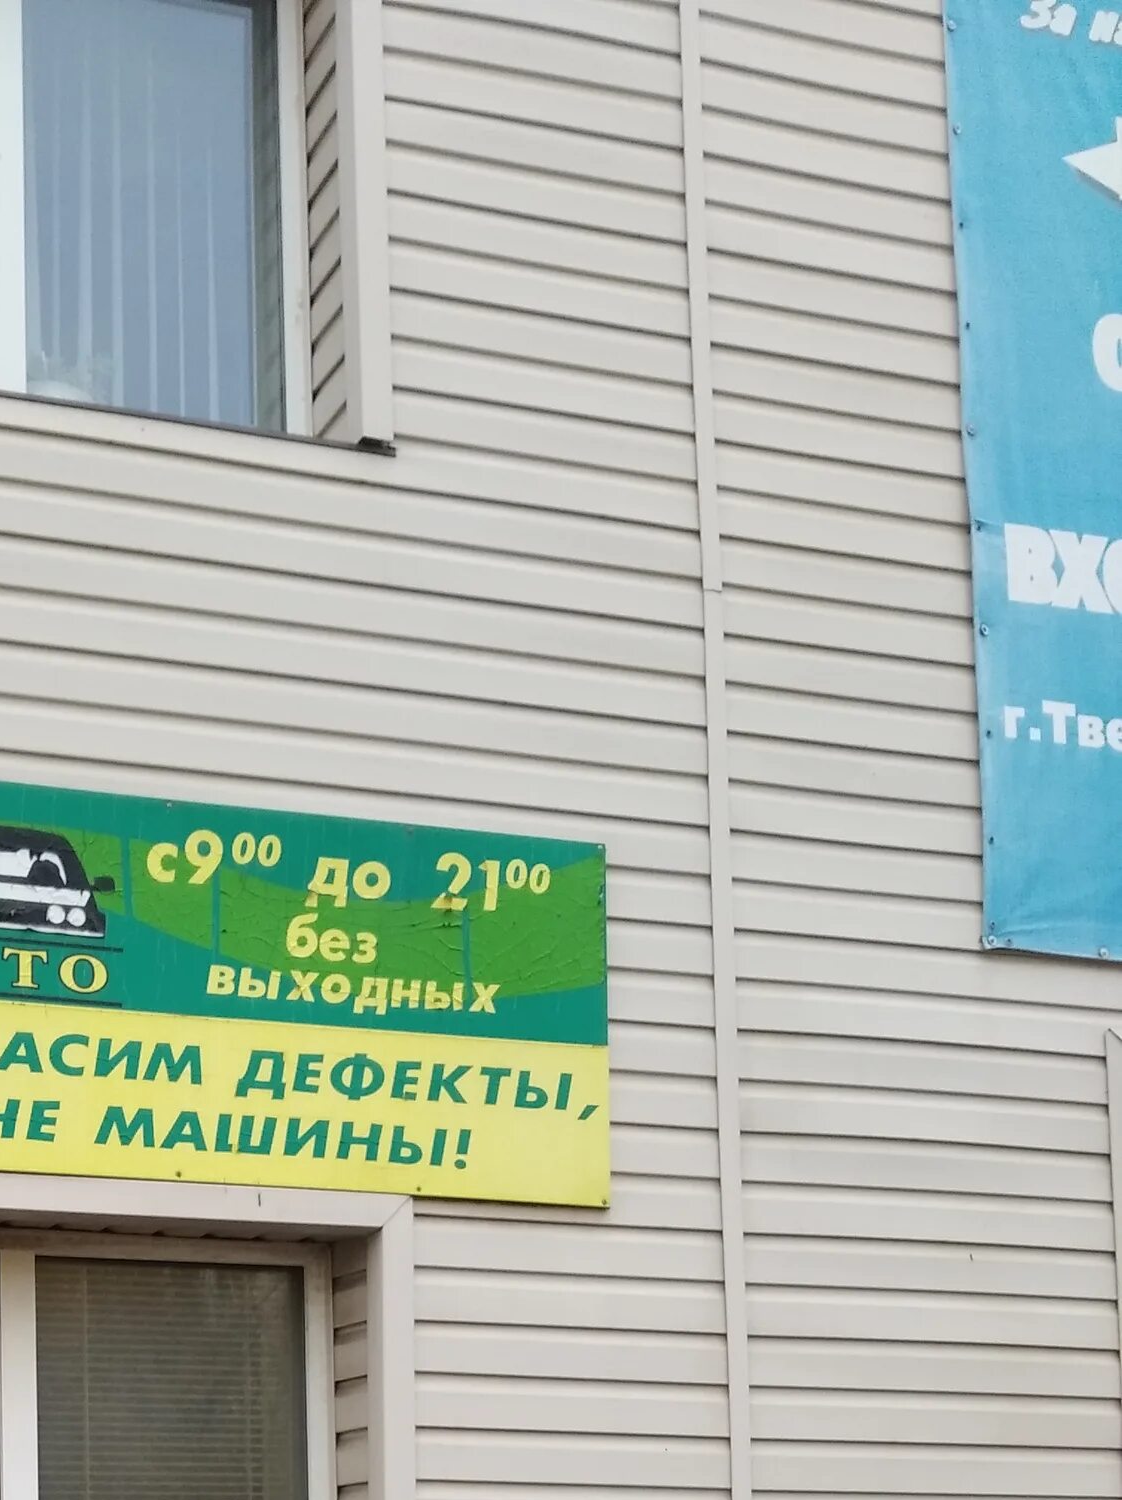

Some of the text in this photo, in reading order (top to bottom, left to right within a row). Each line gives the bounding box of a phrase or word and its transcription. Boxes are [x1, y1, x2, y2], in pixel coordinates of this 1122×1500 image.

[305, 856, 391, 908] до
[285, 912, 378, 964] без
[206, 963, 501, 1015] выходных
[235, 1049, 599, 1121] ДЕФЕКТЫ,
[93, 1105, 474, 1170] МАШИНЫ!
